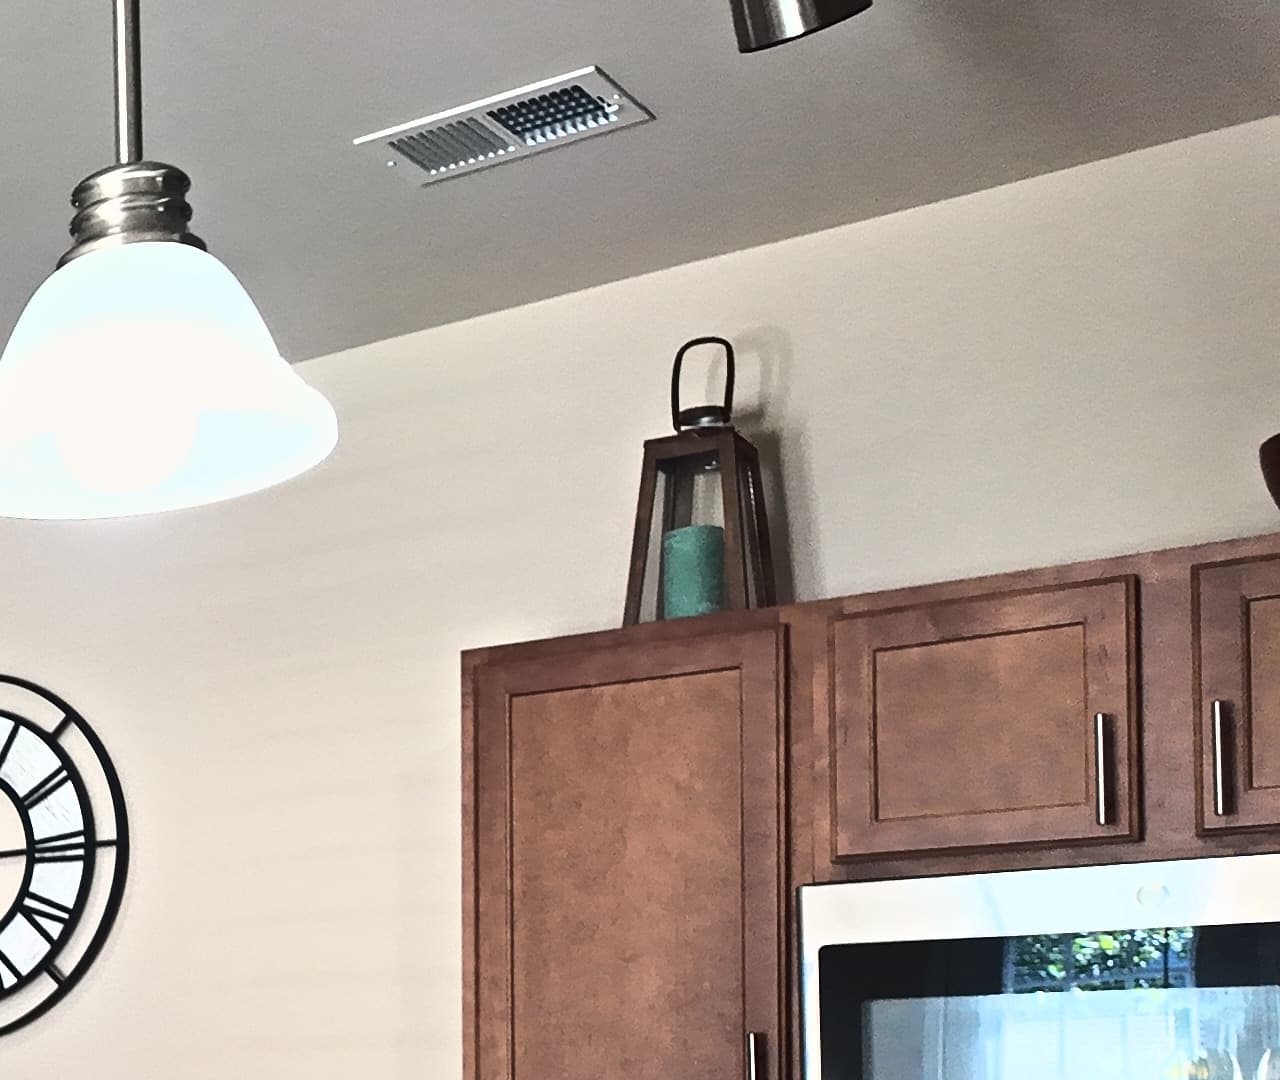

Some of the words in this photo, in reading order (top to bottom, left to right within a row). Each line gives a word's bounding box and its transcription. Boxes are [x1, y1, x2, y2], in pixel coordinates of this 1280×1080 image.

[19, 765, 72, 811] II
[34, 829, 86, 865] III
[18, 890, 74, 947] IV
